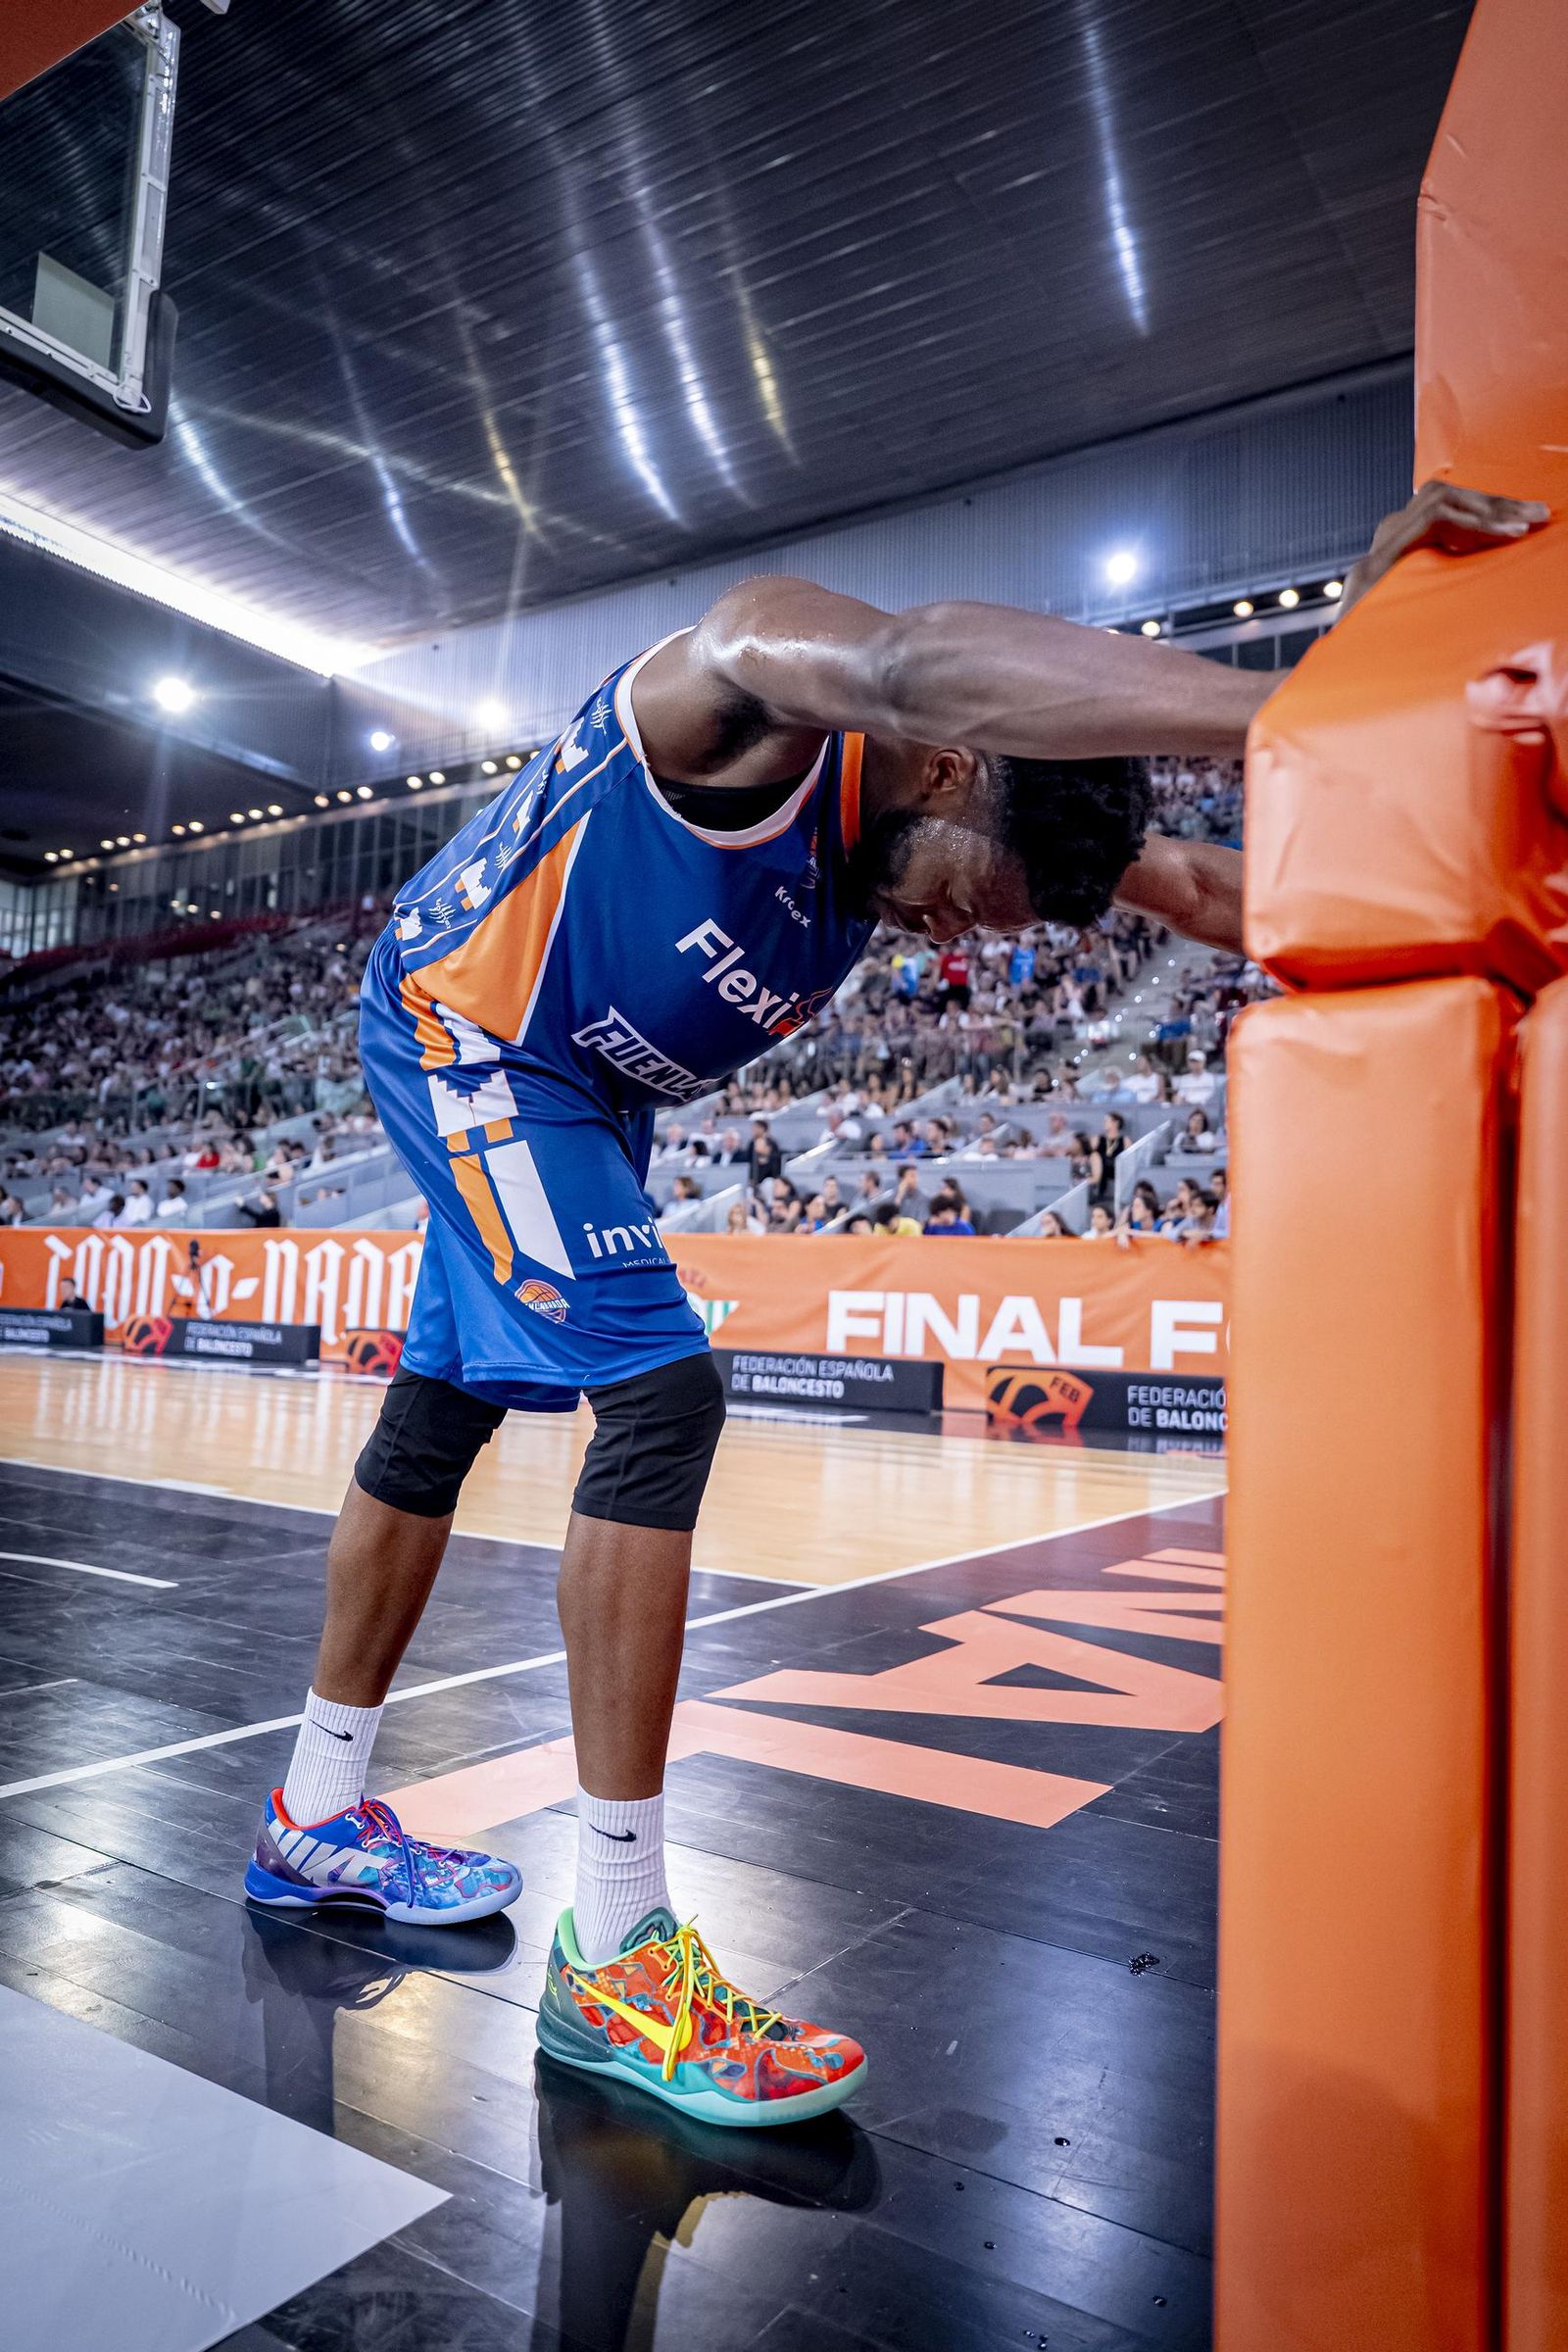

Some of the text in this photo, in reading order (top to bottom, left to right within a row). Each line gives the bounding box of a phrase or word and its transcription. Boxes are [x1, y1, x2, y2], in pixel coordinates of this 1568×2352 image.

[825, 1290, 1231, 1370] FINAL F
[732, 1354, 895, 1383] FEDERACIÓN ESPAÑOLA
[731, 1373, 846, 1399] DE BALONCESTO
[1050, 1376, 1082, 1403] FEB
[1127, 1406, 1152, 1427] DE
